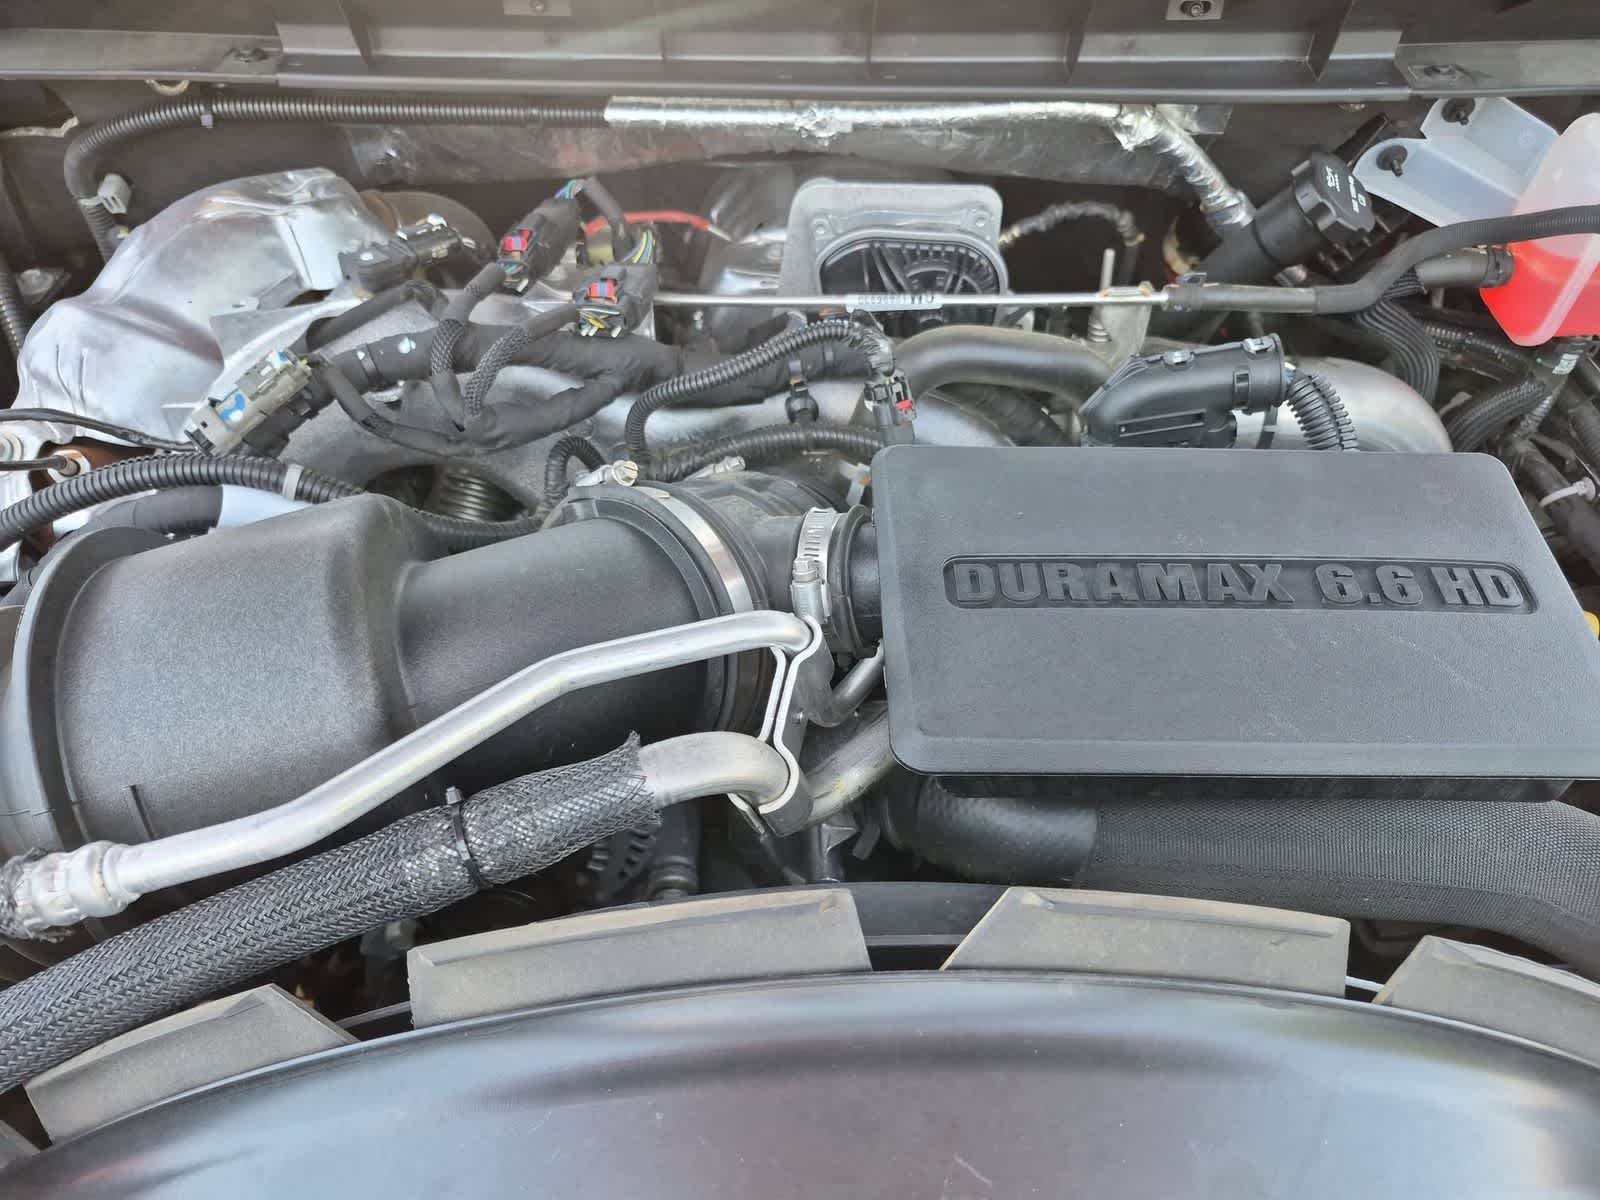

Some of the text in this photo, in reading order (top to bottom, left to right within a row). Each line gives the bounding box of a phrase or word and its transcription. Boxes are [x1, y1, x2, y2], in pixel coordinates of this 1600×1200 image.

[952, 562, 1524, 607] DURAMAX 6.6 HD
